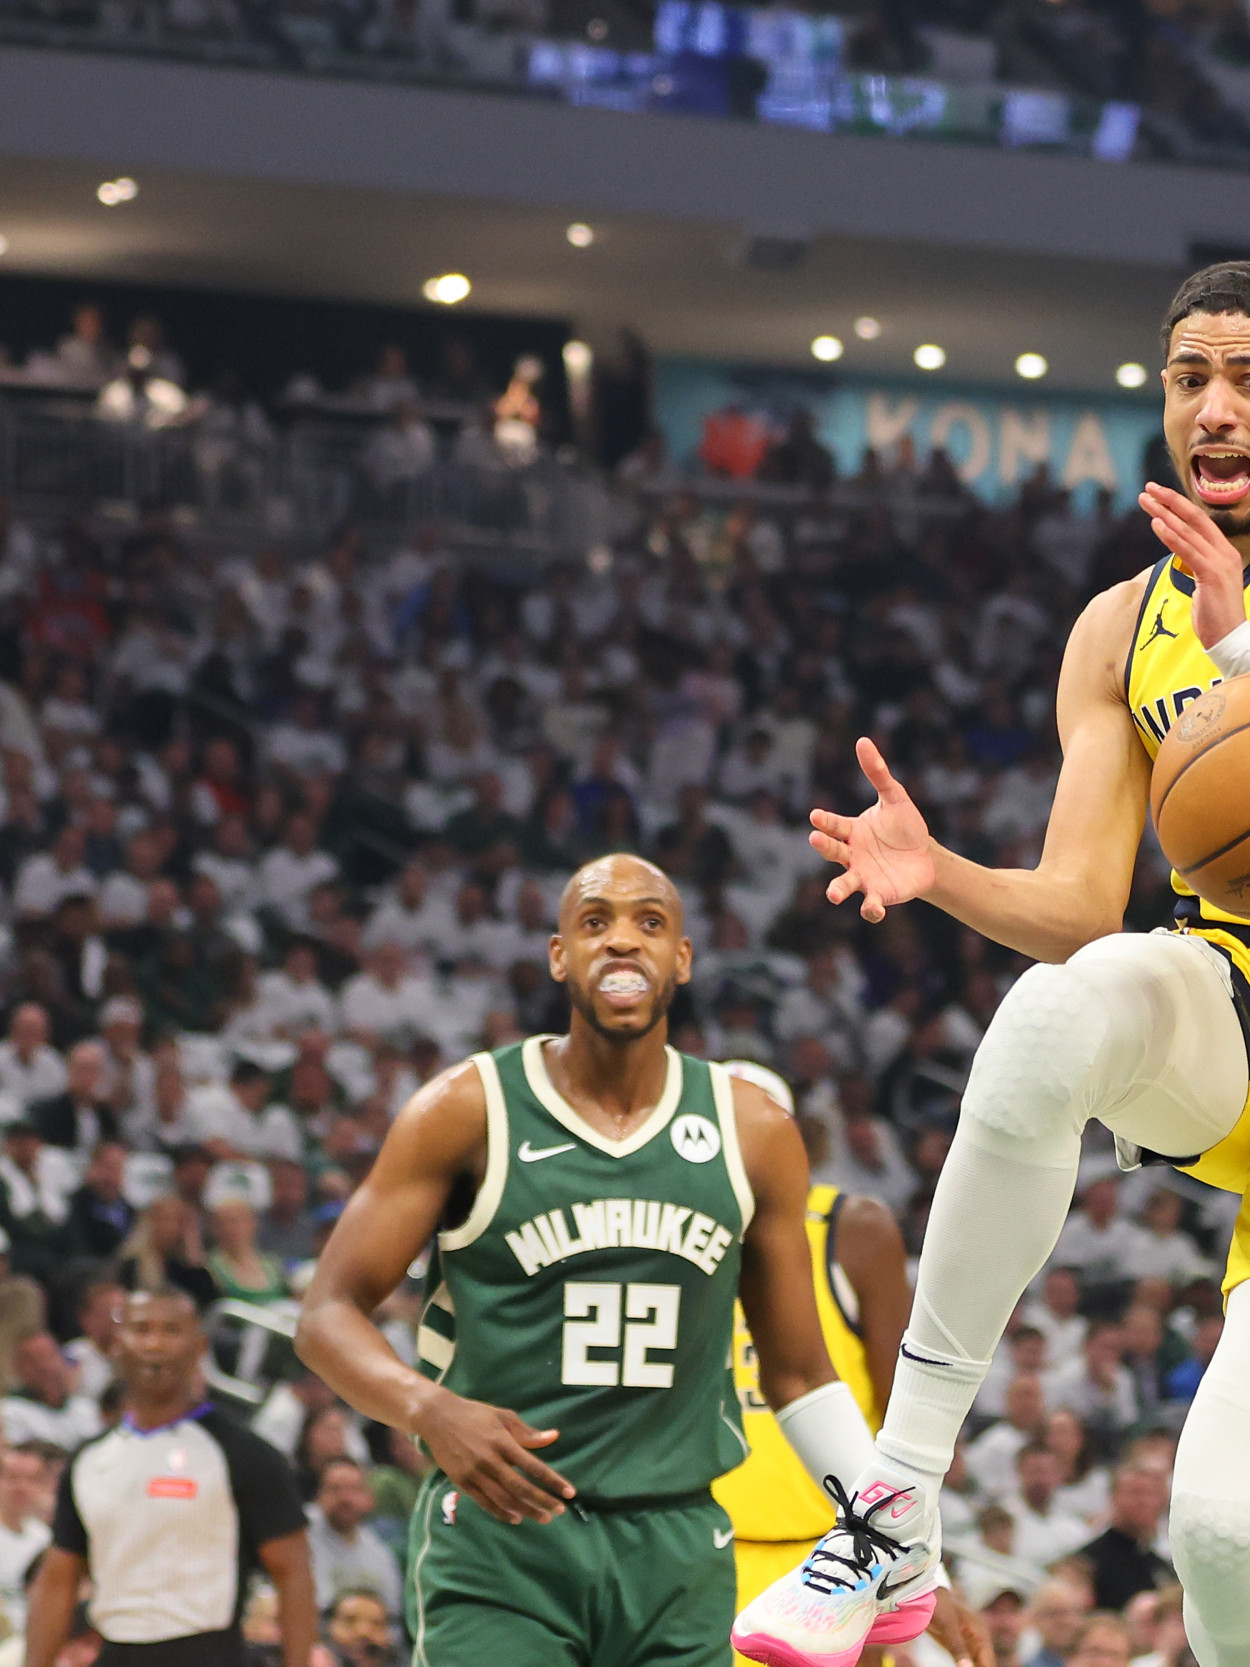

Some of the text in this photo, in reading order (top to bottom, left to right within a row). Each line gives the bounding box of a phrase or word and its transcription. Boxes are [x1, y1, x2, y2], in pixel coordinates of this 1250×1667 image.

[868, 392, 1118, 490] KONA
[504, 1199, 732, 1276] MILWAUKEE
[561, 1281, 681, 1388] 22
